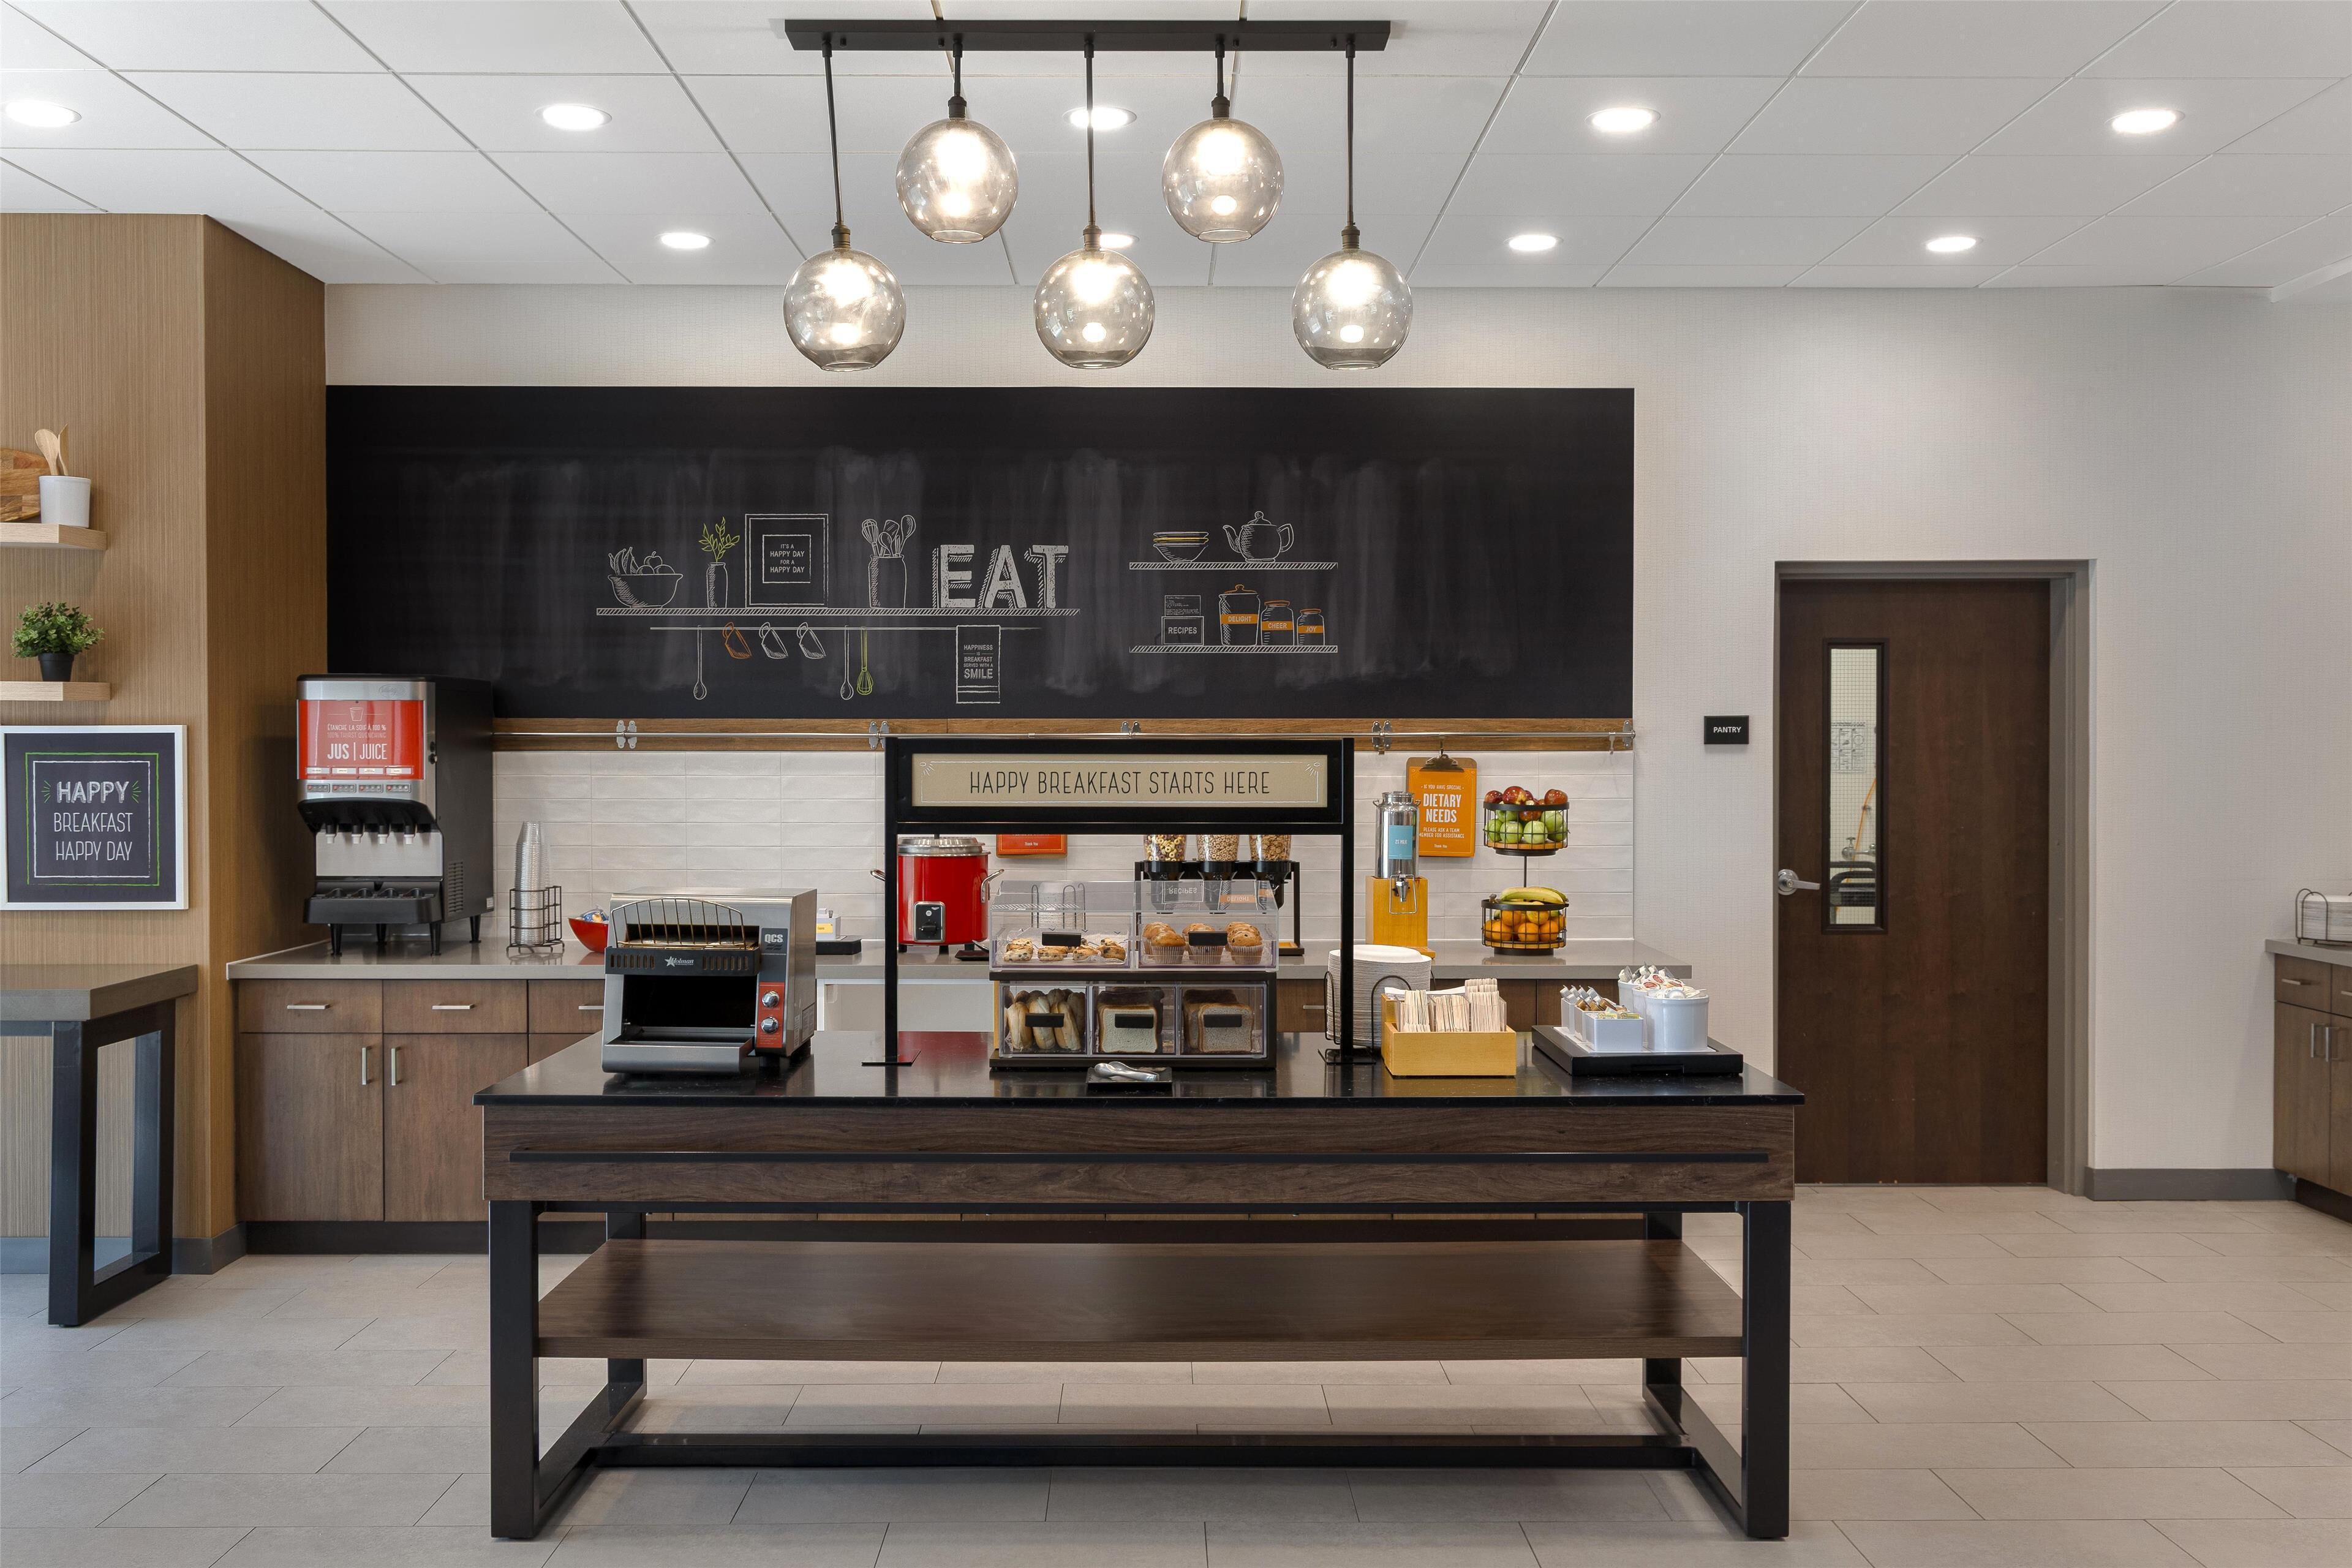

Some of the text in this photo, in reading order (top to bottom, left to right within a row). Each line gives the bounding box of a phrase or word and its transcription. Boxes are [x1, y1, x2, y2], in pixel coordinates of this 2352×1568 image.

[932, 544, 1069, 609] EAT
[964, 668, 993, 679] SMILE
[327, 743, 388, 760] JUS JUICE
[970, 771, 1270, 794] HAPPY BREAKFAST STARTS HERE
[57, 781, 130, 804] HAPPY
[1423, 793, 1461, 808] DIETARY
[54, 812, 134, 832] BREAKFAST
[1426, 809, 1457, 823] NEEDS
[56, 841, 133, 861] HAPPY DAY
[764, 933, 783, 943] QCS
